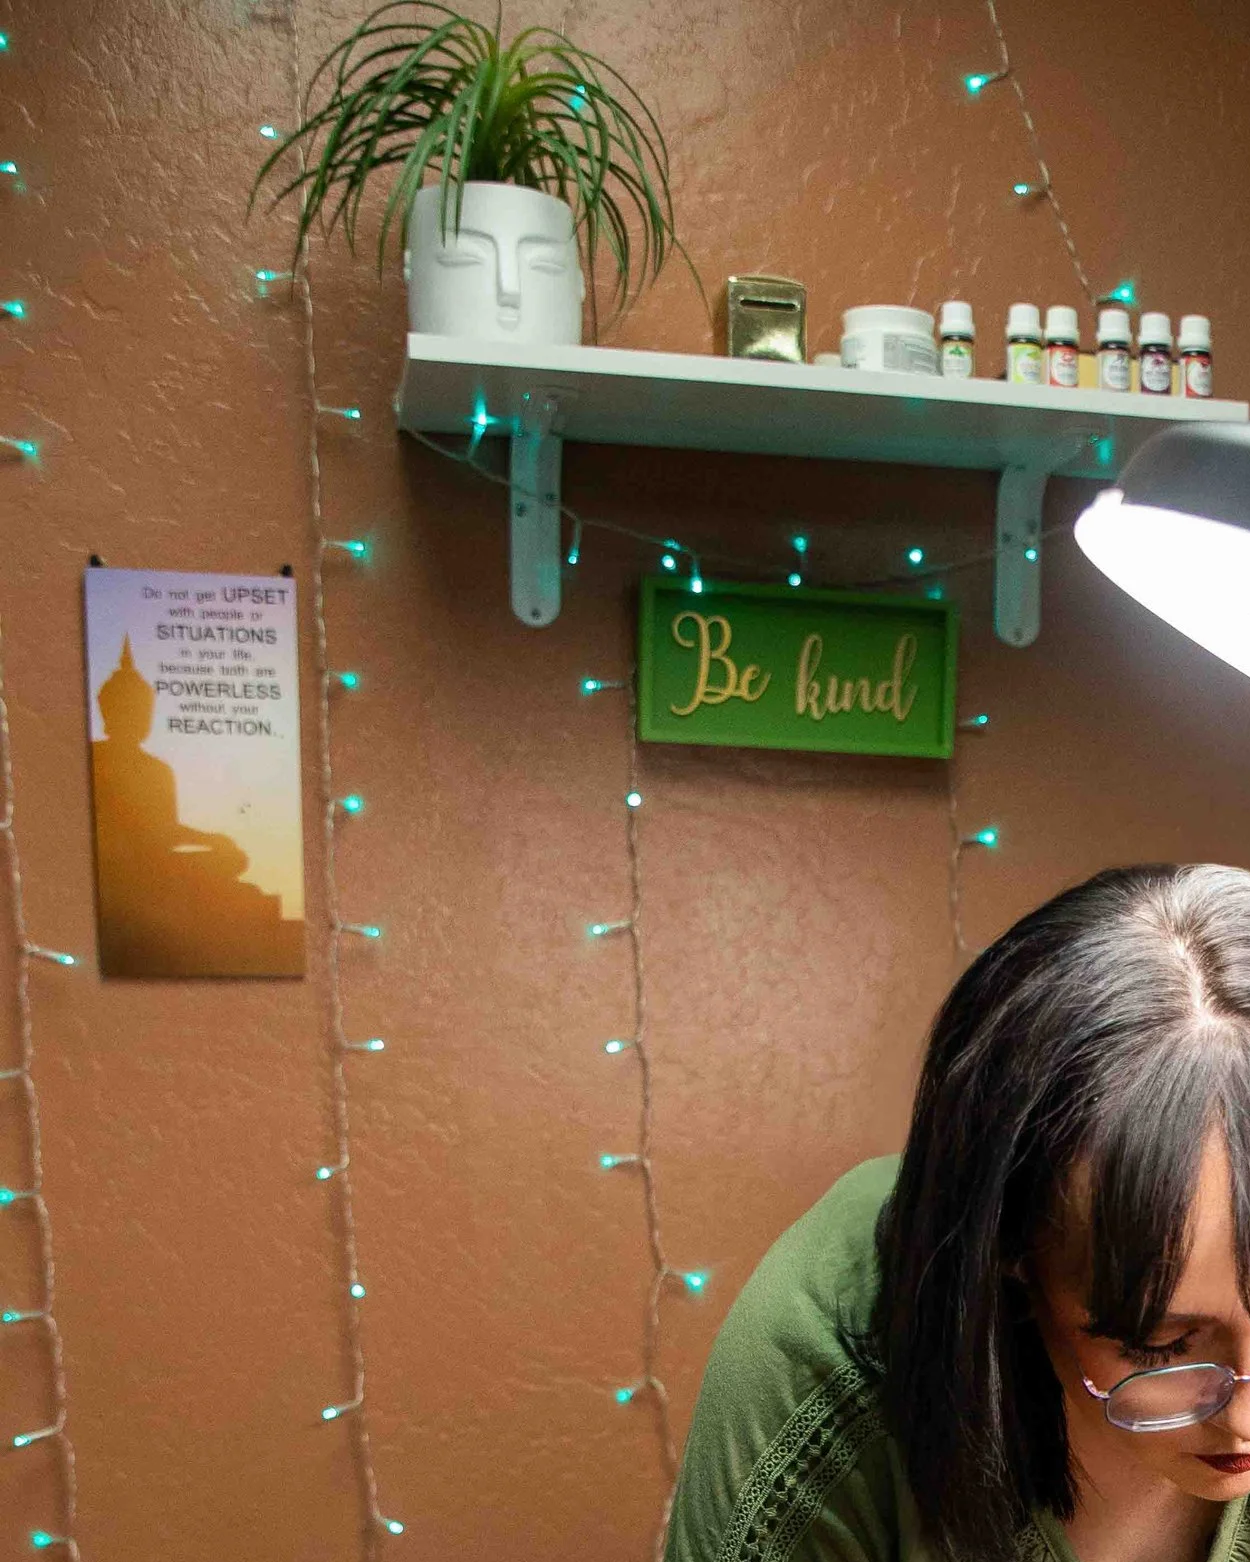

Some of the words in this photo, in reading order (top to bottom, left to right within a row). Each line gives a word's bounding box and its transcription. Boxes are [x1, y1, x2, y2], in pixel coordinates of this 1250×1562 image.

[169, 589, 189, 600] not
[196, 590, 216, 604] get
[222, 587, 289, 605] UPSET
[169, 607, 194, 618] with
[202, 609, 244, 621] people
[156, 624, 278, 644] SITUATIONS
[199, 649, 226, 660] your
[159, 663, 215, 675] because
[221, 665, 248, 676] both
[255, 667, 276, 678] are
[670, 611, 772, 716] Be
[795, 632, 918, 721] kind
[155, 680, 282, 700] POWERLESS
[179, 702, 225, 714] without
[232, 704, 259, 716] your
